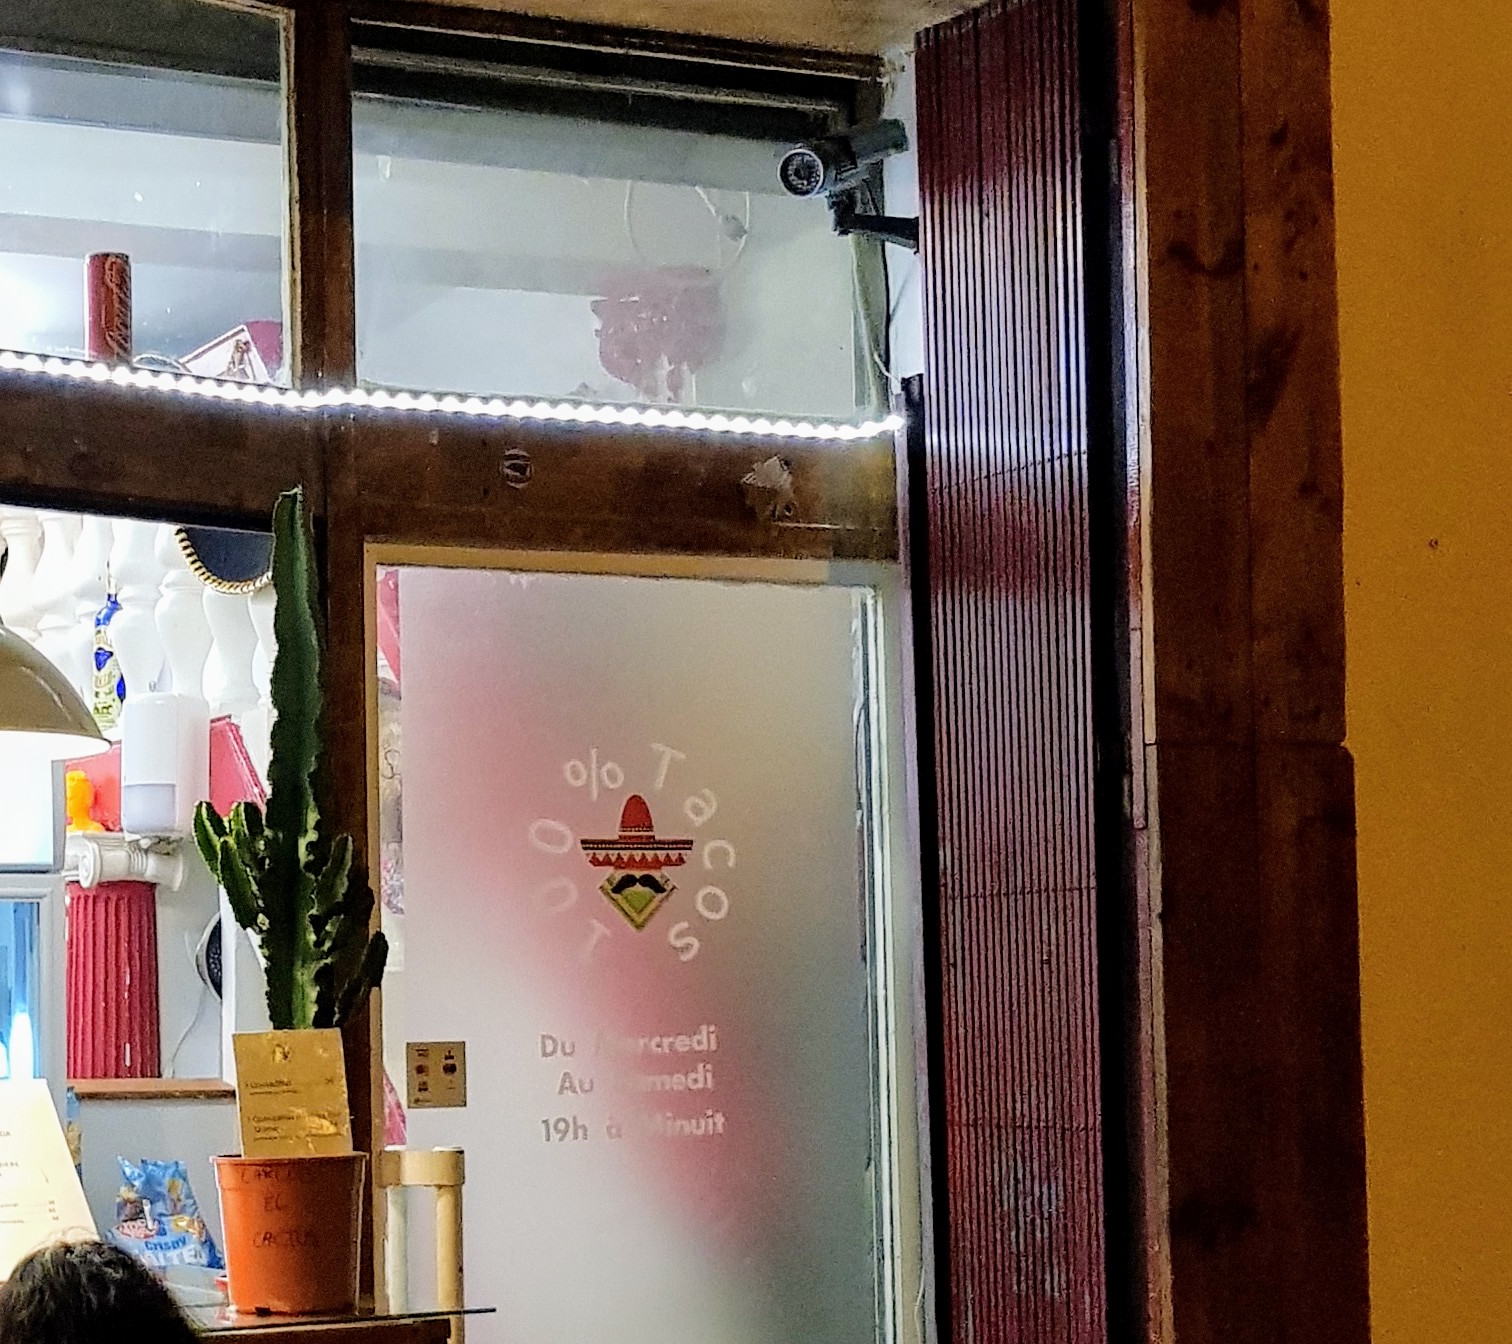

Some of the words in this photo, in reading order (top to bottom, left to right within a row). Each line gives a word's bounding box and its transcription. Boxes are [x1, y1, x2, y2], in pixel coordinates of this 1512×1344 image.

[540, 1032, 576, 1058] Du
[595, 1023, 719, 1054] rcredi
[556, 1069, 594, 1095] Au
[614, 1062, 715, 1091] medi
[540, 1114, 589, 1143] 19h
